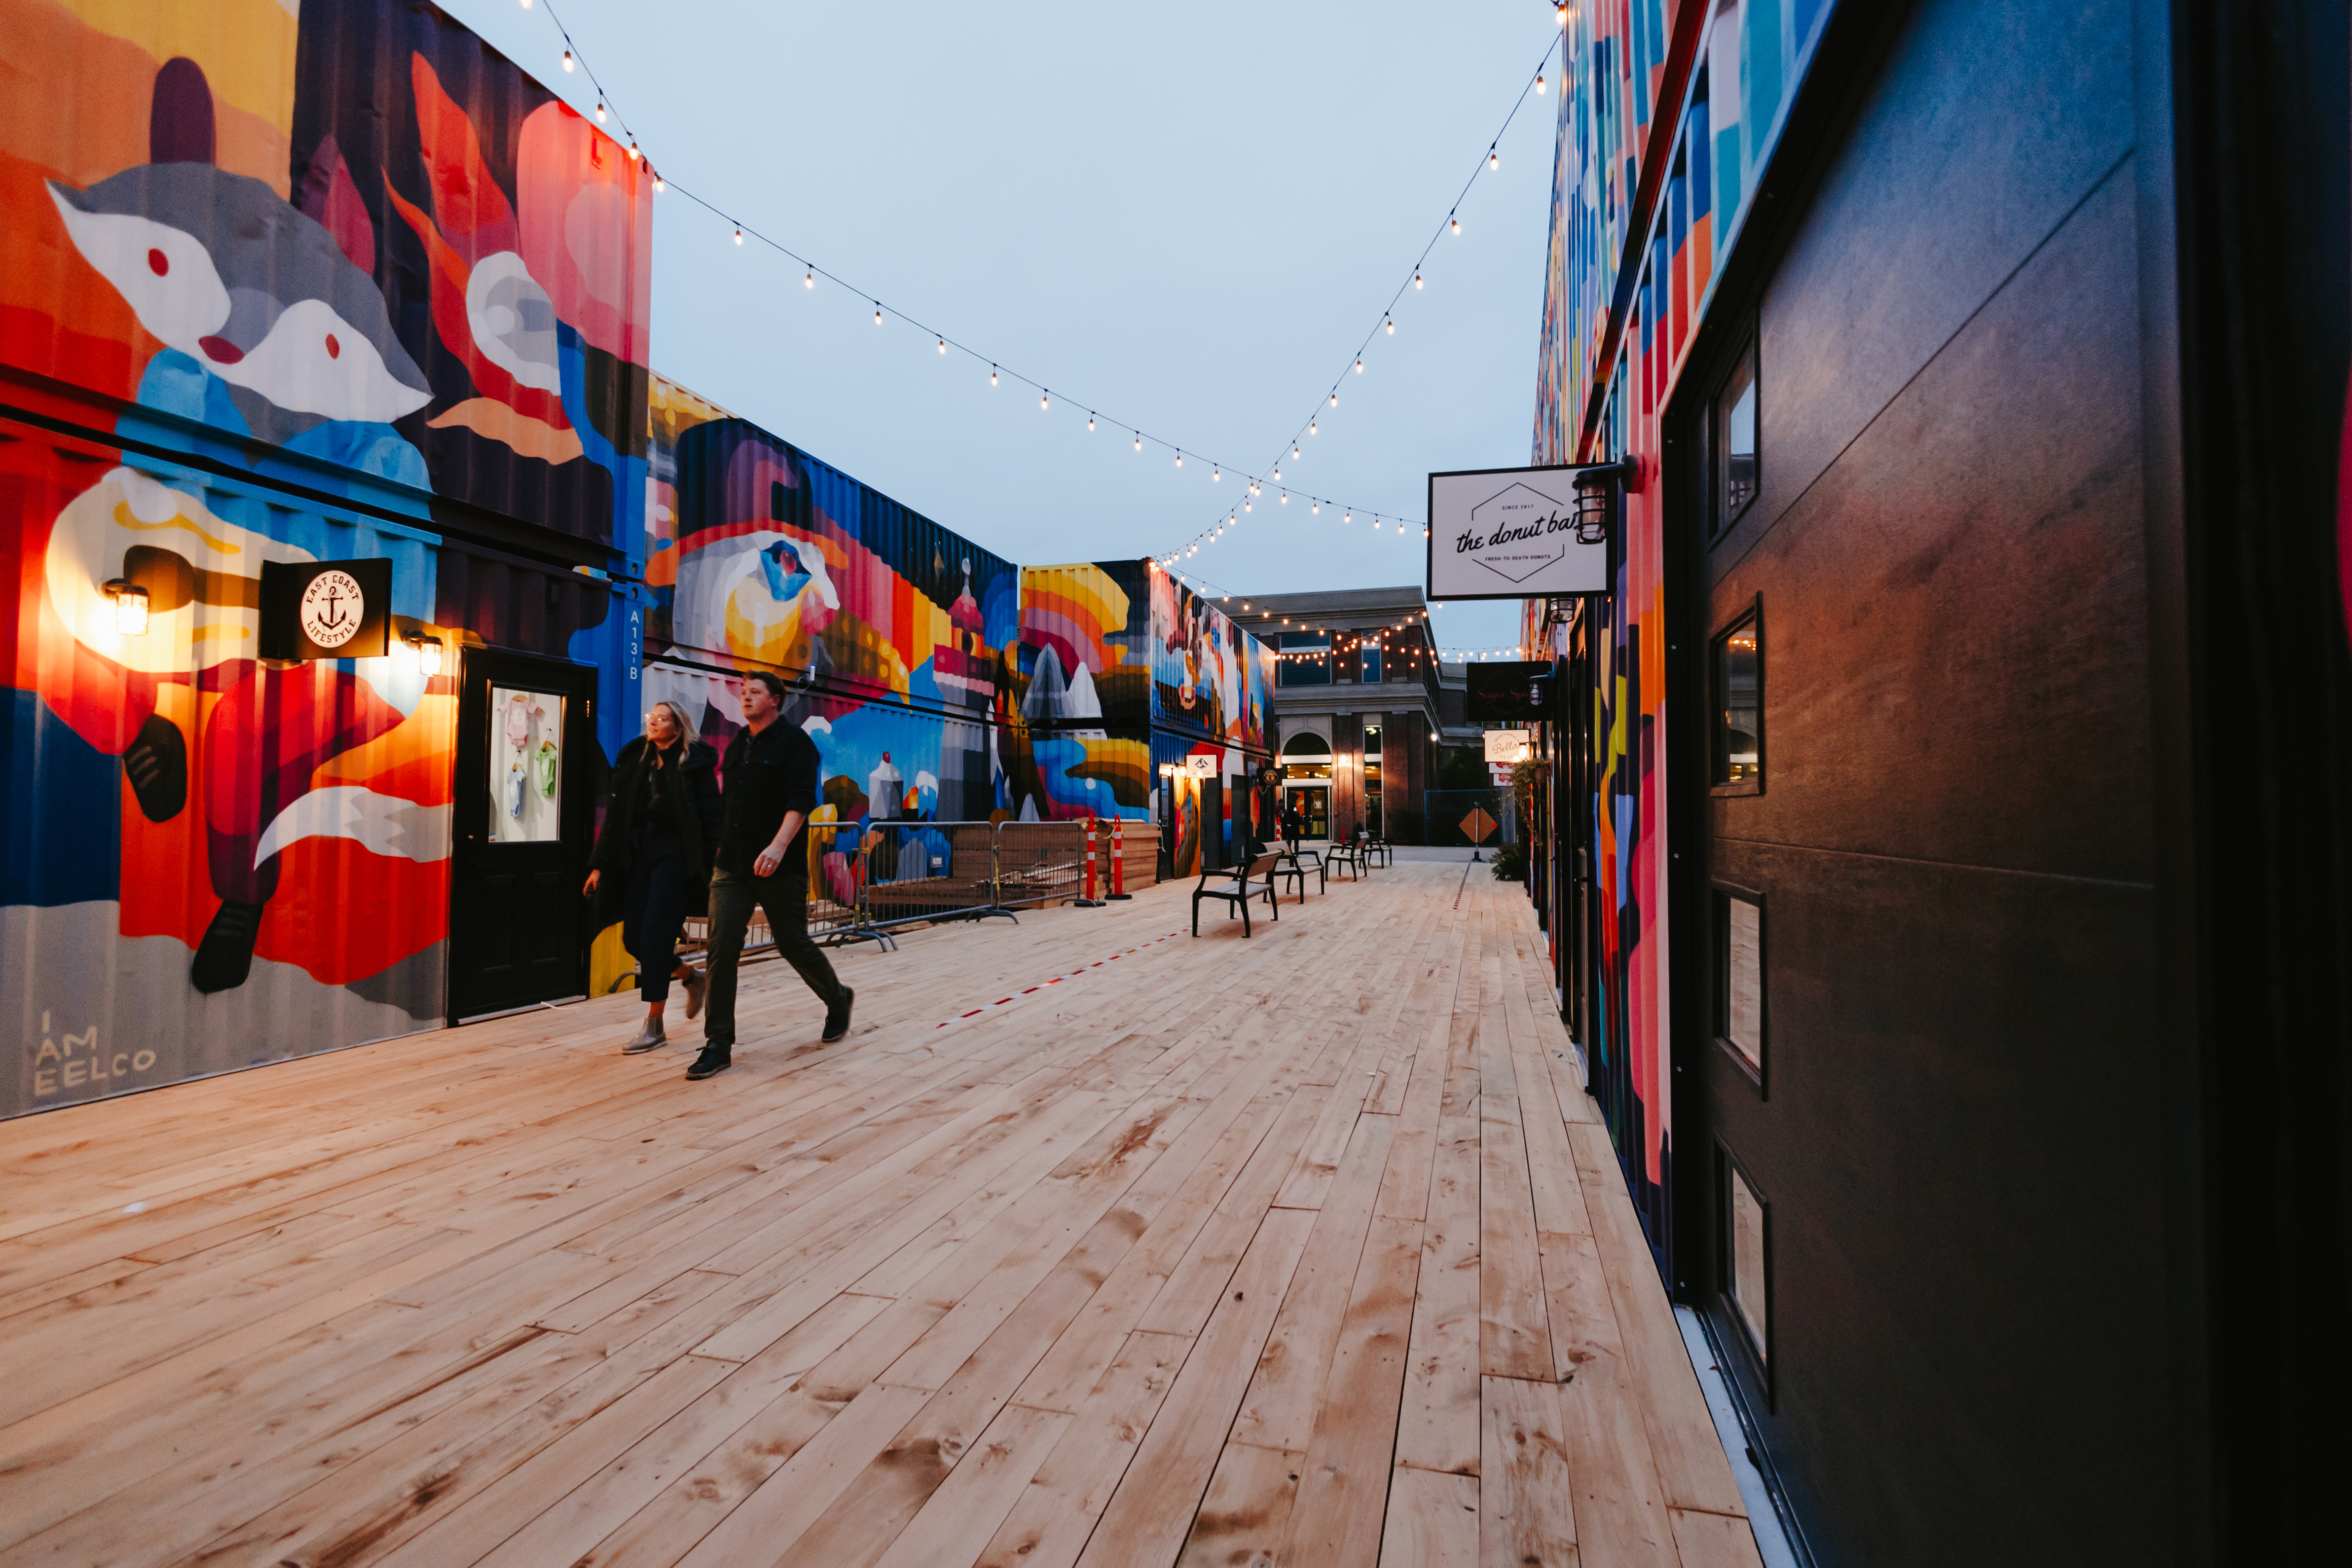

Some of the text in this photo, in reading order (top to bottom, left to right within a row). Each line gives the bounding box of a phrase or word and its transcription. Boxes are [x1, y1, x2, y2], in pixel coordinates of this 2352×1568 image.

[1456, 529, 1484, 553] the
[1489, 516, 1545, 546] donut
[306, 575, 360, 604] EAST COAST
[307, 619, 356, 644] LIFESTYLE
[42, 1010, 50, 1034] I
[36, 1026, 98, 1066] AM
[34, 1050, 156, 1096] EELCO
